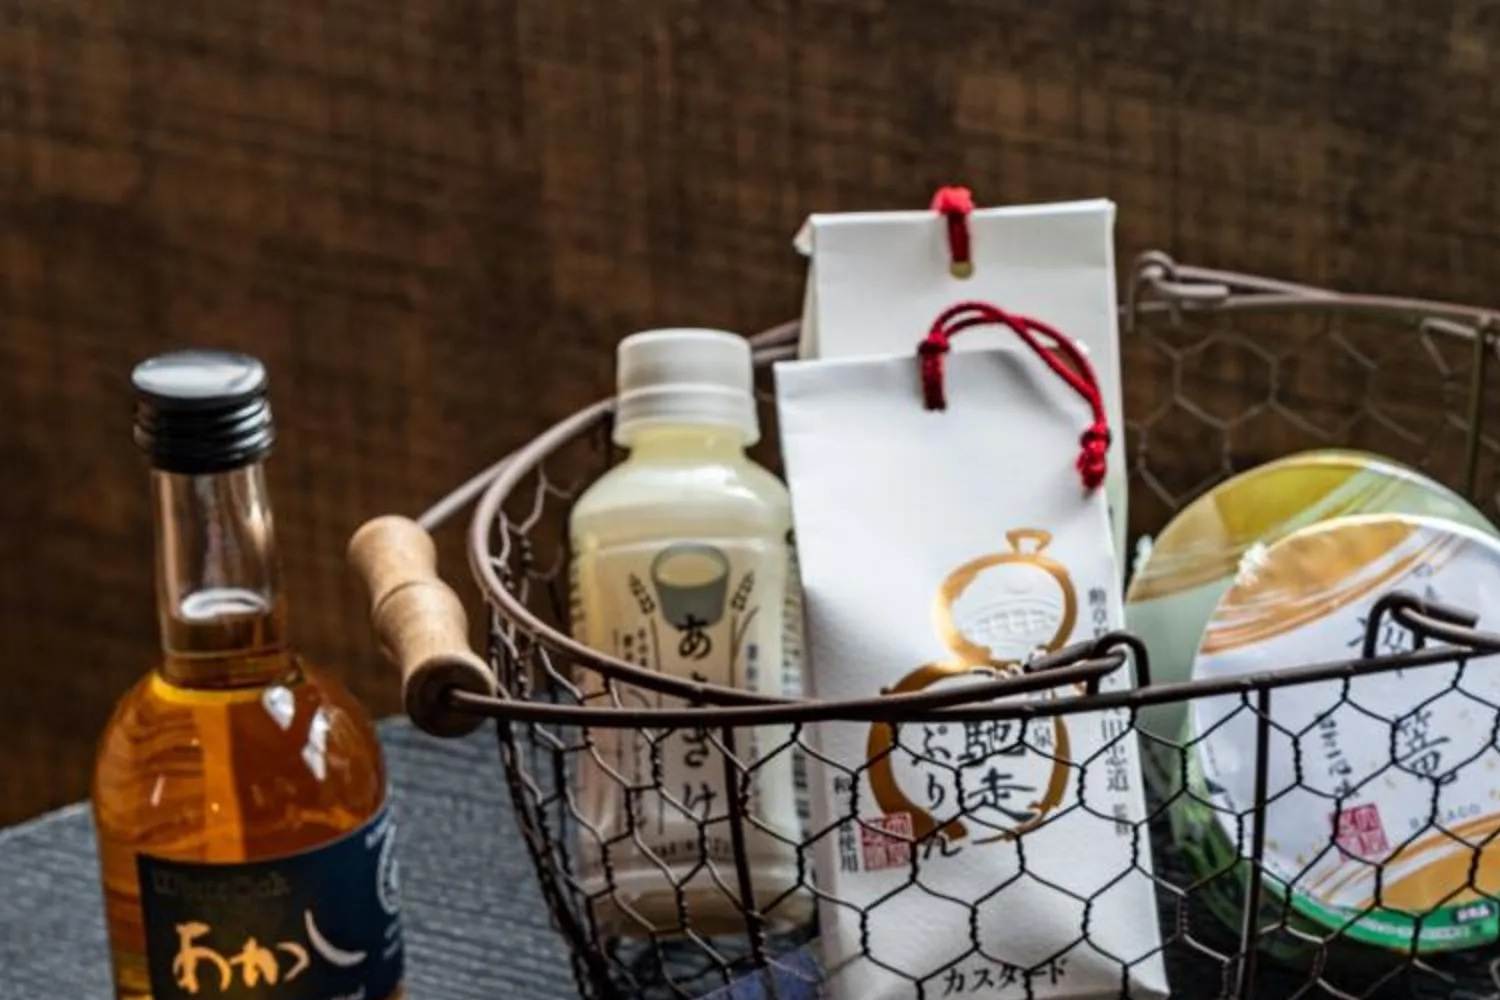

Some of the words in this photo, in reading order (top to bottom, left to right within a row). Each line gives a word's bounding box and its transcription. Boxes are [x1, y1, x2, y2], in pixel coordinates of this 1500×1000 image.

[957, 718, 1037, 823] 馳走
[172, 908, 367, 994] あかし
[942, 958, 1069, 998] カスタード
